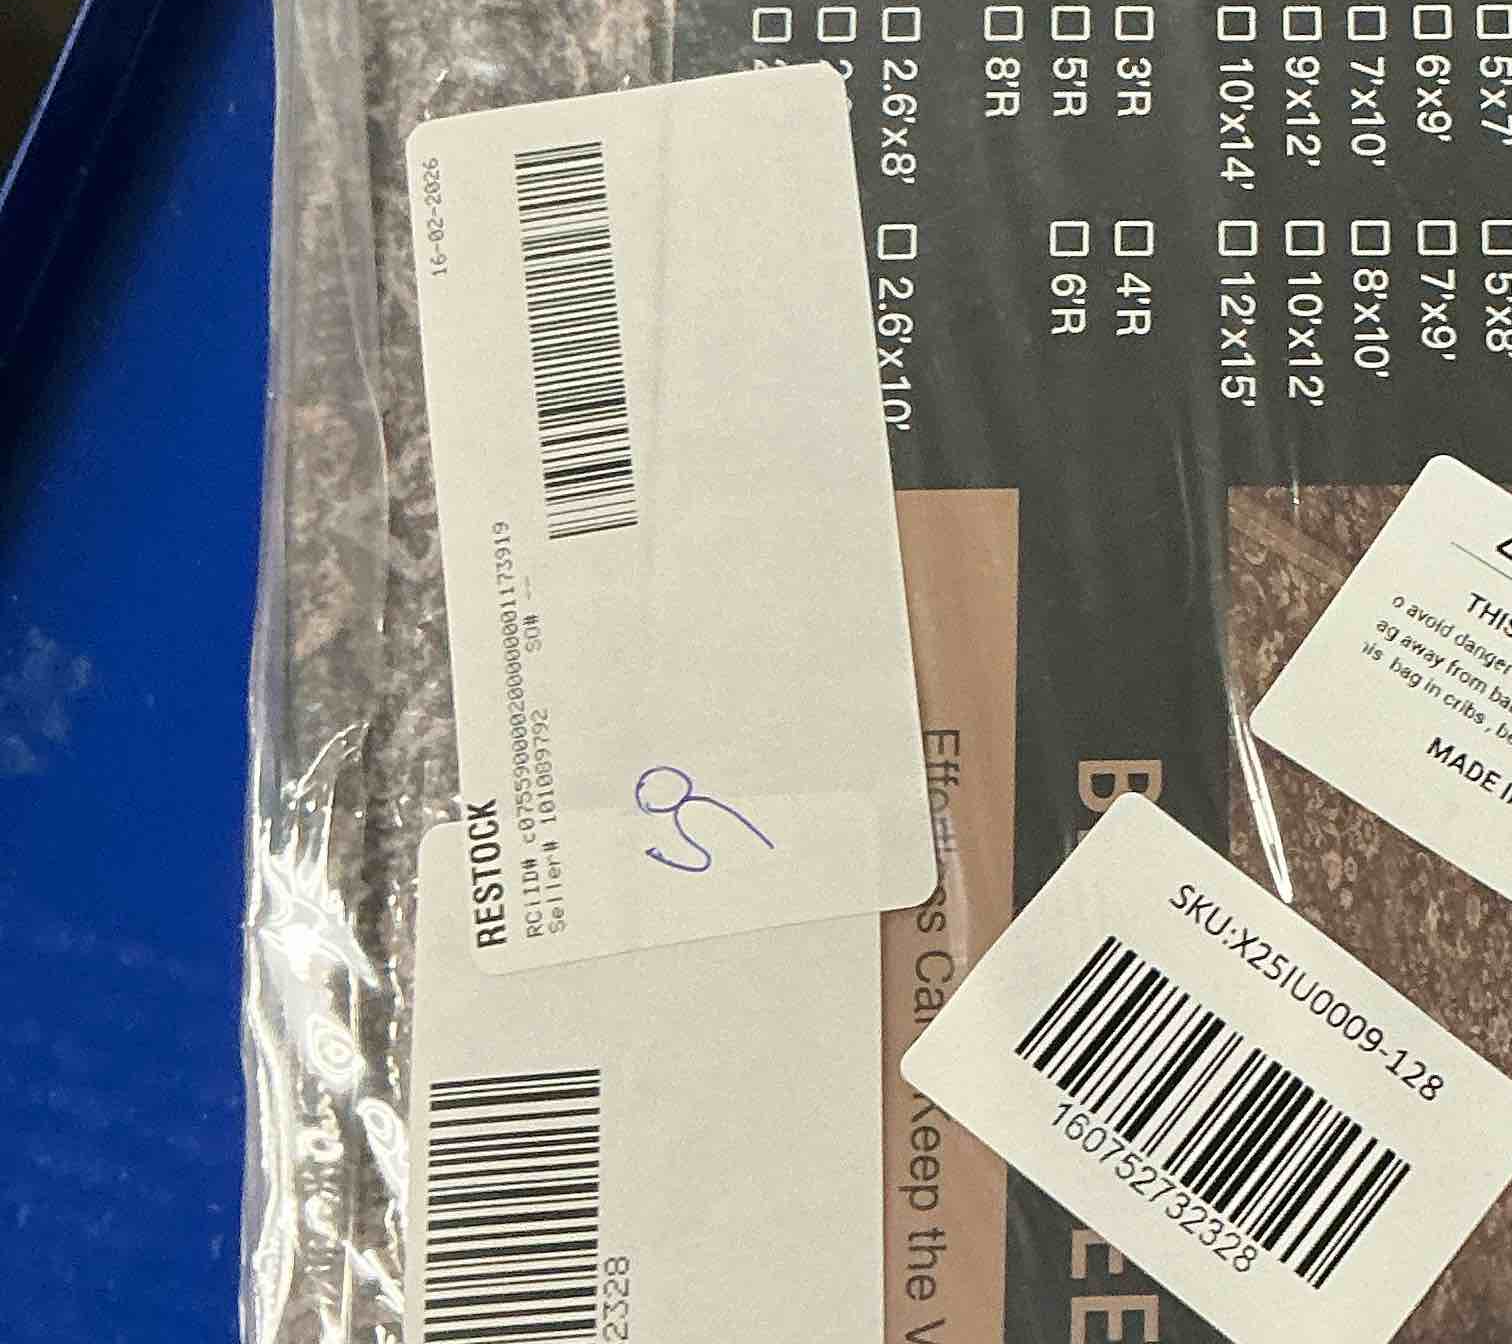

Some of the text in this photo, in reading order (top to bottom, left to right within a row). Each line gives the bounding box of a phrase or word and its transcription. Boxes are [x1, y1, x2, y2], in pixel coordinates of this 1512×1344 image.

[881, 59, 918, 183] 2.6'x8'
[985, 57, 1020, 117] 8'R
[1053, 58, 1088, 116] 5'R
[1117, 58, 1152, 116] 3'R
[1220, 59, 1255, 189] 10'x14'
[1285, 56, 1321, 166] 9'x12'
[1350, 57, 1386, 166] 7'x10'
[1416, 55, 1452, 141] 6'x9'
[423, 156, 448, 278] 16-02-2026
[1051, 274, 1087, 334] 6'R
[1116, 273, 1151, 336] 4'R
[1221, 272, 1256, 406] 12'x15'
[1288, 272, 1324, 406] 10'x12'
[1353, 269, 1389, 377] 8'x10'
[1421, 269, 1457, 360] 7'x9'
[879, 277, 913, 430] 2.6'x10'
[1375, 619, 1401, 643] ag
[1399, 635, 1448, 670] away
[1444, 659, 1488, 695] from
[1405, 604, 1457, 639] avoid
[1388, 655, 1424, 689] bag
[1423, 677, 1443, 698] in
[1425, 736, 1503, 794] MADE
[465, 798, 508, 950] RESTOCK
[541, 839, 568, 935] Seller#
[1168, 883, 1446, 1102] SKU:X25IU0009-128
[1052, 1102, 1258, 1273] 160752732328
[907, 1229, 947, 1301] the
